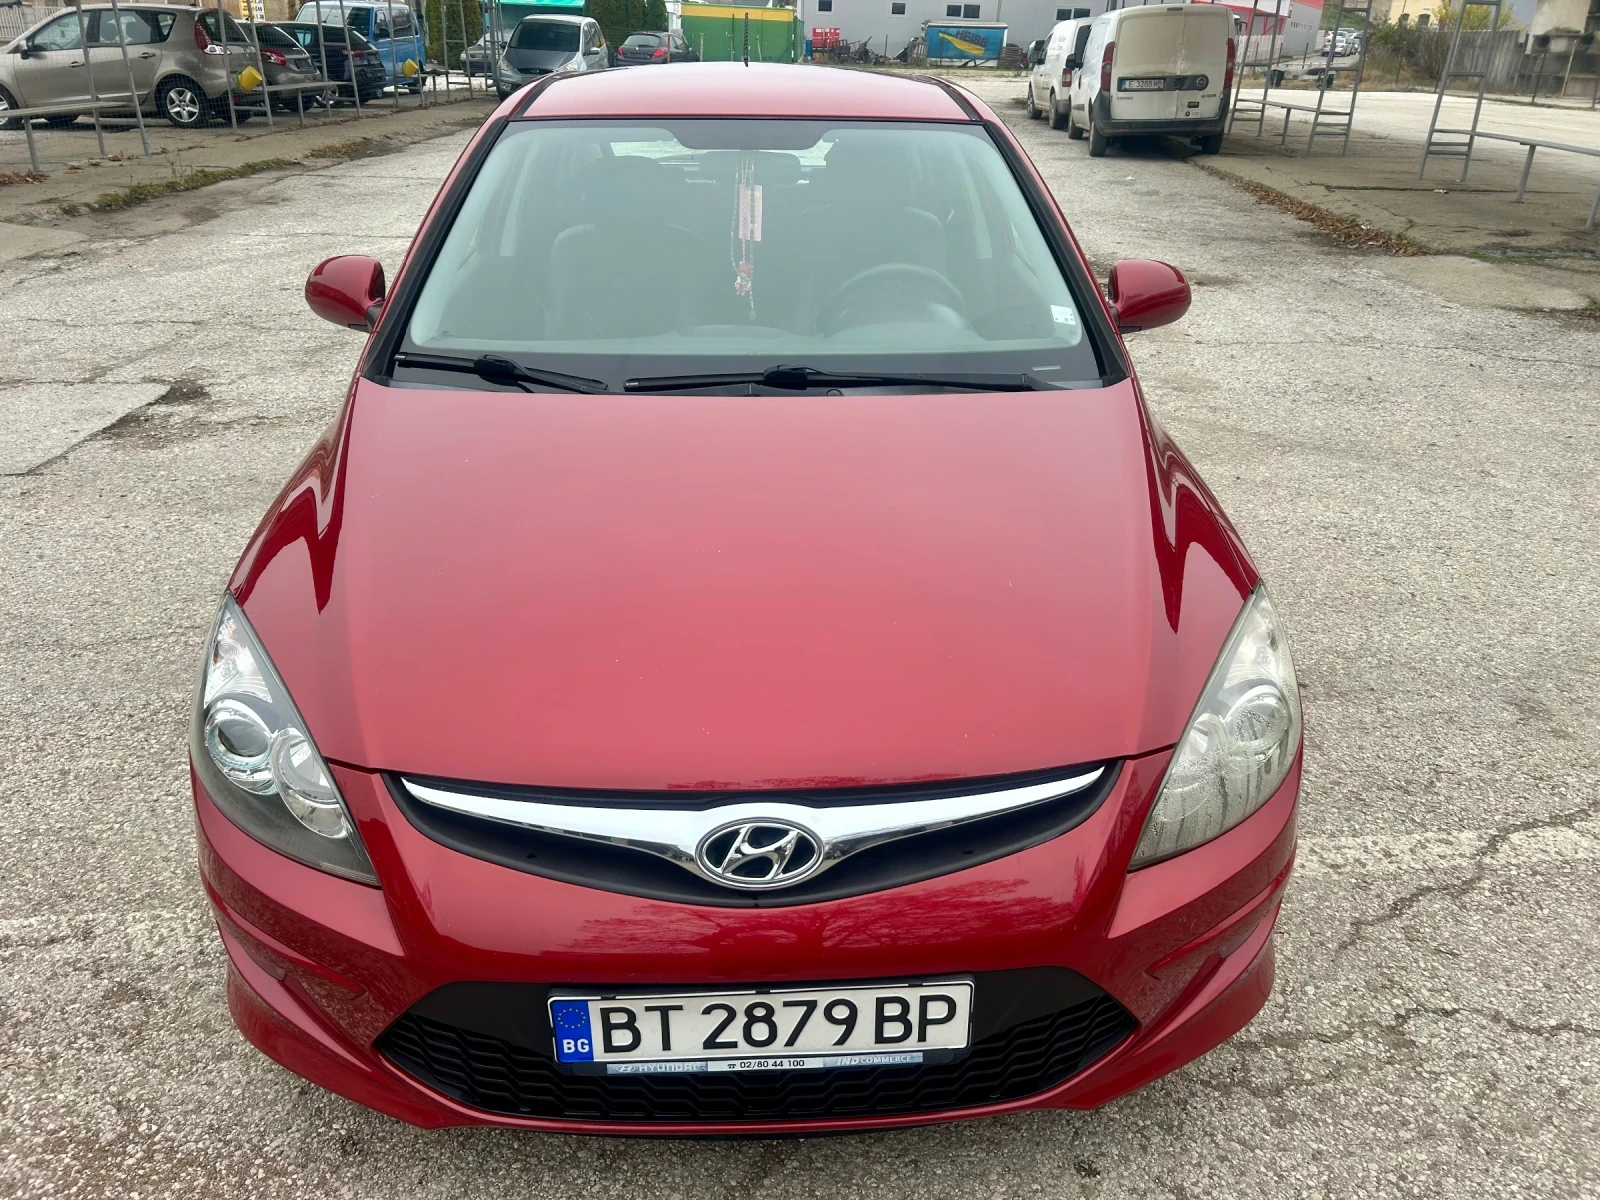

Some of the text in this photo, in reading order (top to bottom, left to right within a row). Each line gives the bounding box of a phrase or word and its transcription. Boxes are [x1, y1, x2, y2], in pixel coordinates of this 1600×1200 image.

[955, 30, 989, 48] HEISS
[1136, 80, 1153, 88] 3288
[600, 993, 957, 1053] BT 2879 BP
[562, 1038, 590, 1054] BG
[639, 1062, 697, 1072] HYUNDAI
[739, 1059, 805, 1069] 02/80 44 100
